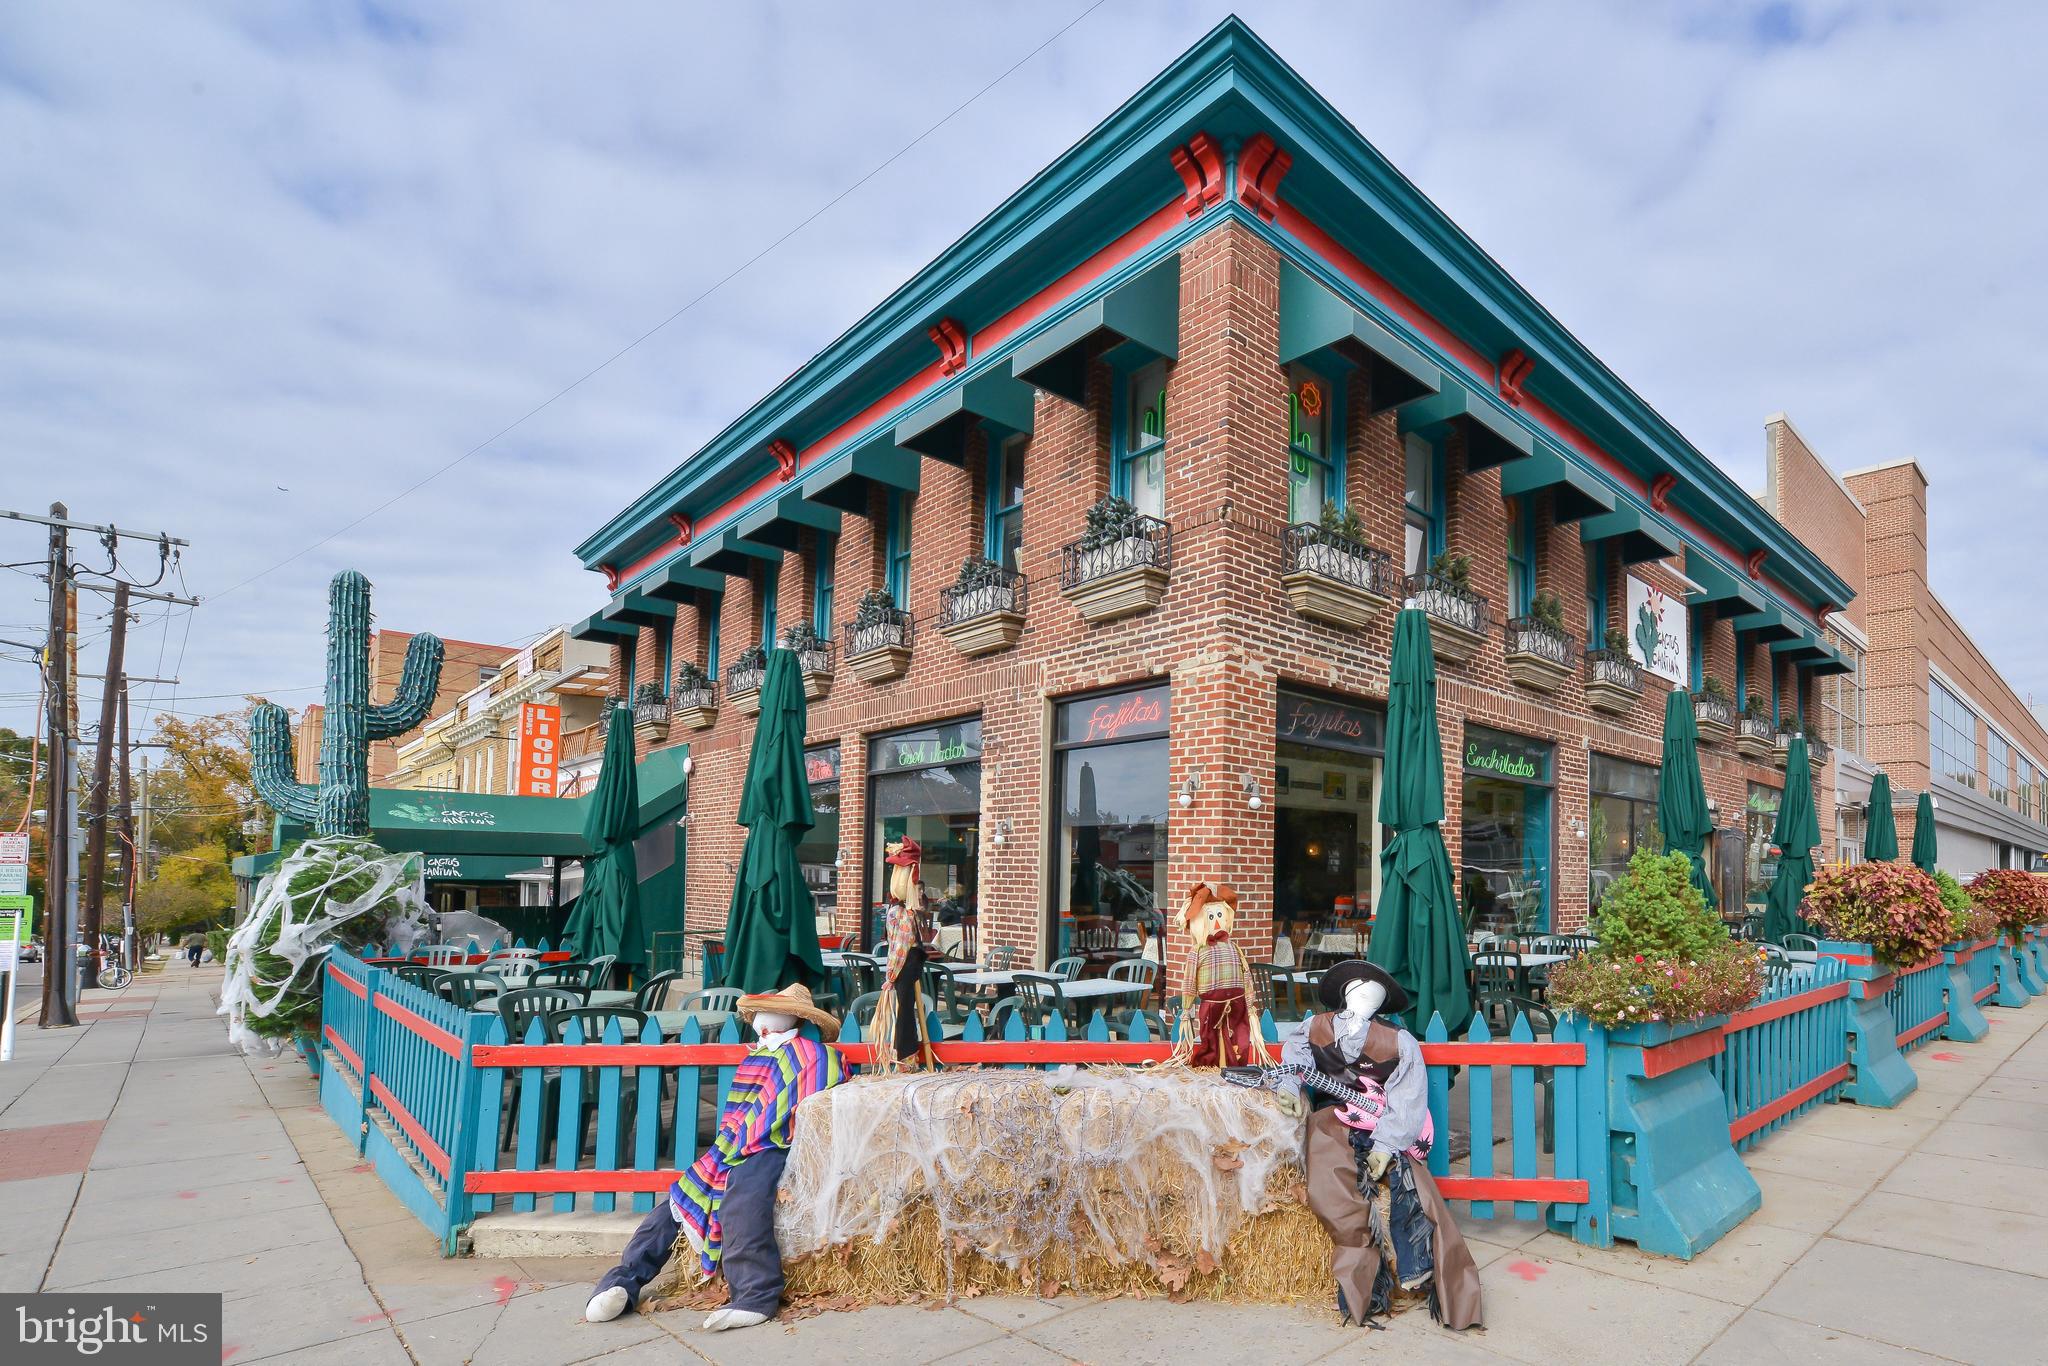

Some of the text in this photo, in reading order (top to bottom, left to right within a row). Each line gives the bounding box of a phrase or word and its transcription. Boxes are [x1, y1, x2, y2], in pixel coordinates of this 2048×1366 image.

[531, 708, 554, 794] LIQUOR
[1466, 743, 1536, 778] Enchiladas
[441, 810, 495, 819] CACTUS
[427, 857, 460, 867] CACTUS
